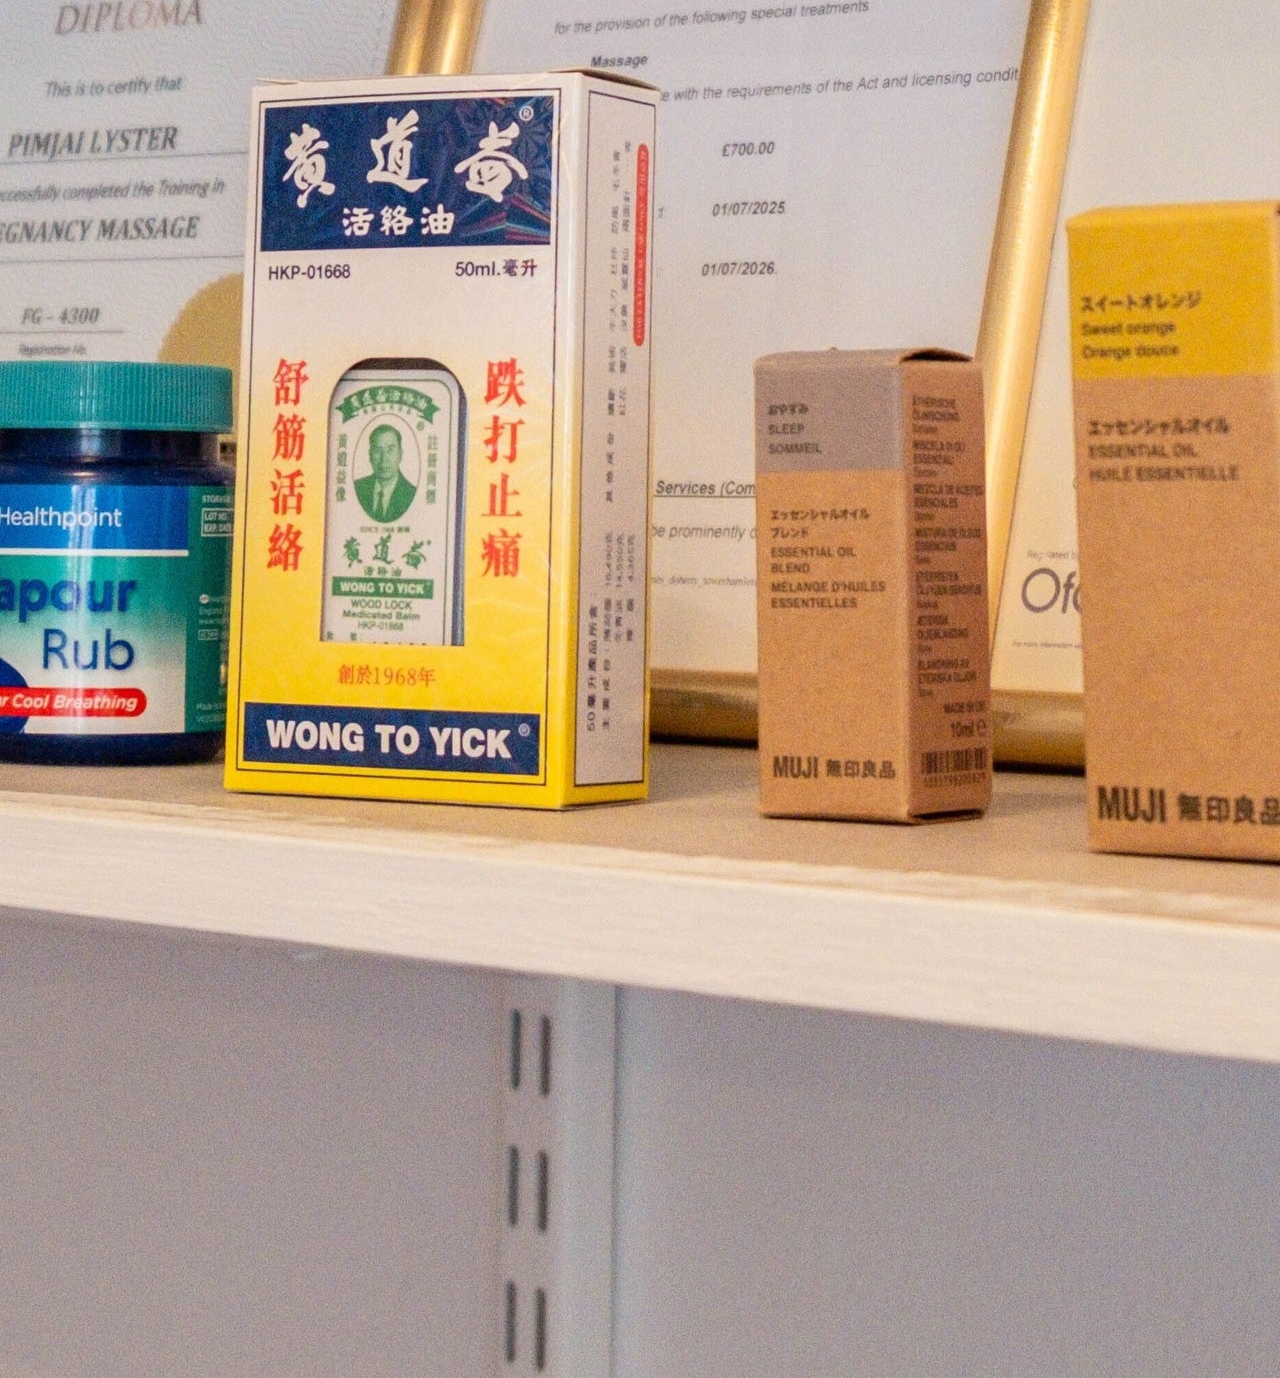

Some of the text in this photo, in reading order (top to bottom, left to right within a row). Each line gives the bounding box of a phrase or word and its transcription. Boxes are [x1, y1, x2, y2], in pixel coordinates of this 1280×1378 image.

[595, 15, 650, 33] provision
[670, 12, 689, 26] the
[692, 7, 746, 25] following
[751, 4, 795, 24] special
[590, 54, 648, 70] Massage
[46, 76, 183, 97] This certify that
[673, 87, 699, 102] with
[703, 85, 723, 100] the
[726, 81, 812, 101] requirements
[816, 79, 830, 94] of
[832, 78, 853, 93] the
[857, 76, 879, 92] Act
[882, 74, 908, 90] and
[912, 69, 972, 88] licensing
[976, 68, 1019, 83] condit
[7, 125, 179, 162] PIMJAI LYSTER
[722, 141, 776, 157] £700.00
[63, 183, 130, 202] completed
[132, 181, 153, 196] the
[160, 177, 210, 198] Training
[712, 200, 786, 217] 01/07/2025
[96, 215, 200, 241] MASSAGE
[342, 204, 456, 237] 活絡油
[268, 263, 351, 281] HKP-01668
[455, 258, 539, 278] 50ml.毫升
[60, 307, 101, 325] 4300
[1126, 322, 1176, 338] orange
[1082, 345, 1131, 361] Orange
[768, 424, 804, 435] SLEEP
[768, 443, 823, 455] SOMMEIL
[266, 357, 310, 572] 舒筋活絡
[481, 357, 527, 578] 跌打止痛
[655, 480, 716, 495] Services
[669, 524, 746, 543] prominently
[771, 546, 856, 557] ESSENTIAL OIL
[771, 563, 810, 574] BLEND
[340, 581, 425, 595] WONG TO YICK
[771, 580, 829, 593] MÉLANGE
[351, 599, 413, 611] WOOD LOCK
[771, 597, 859, 609] ESSENTIELLES
[342, 610, 421, 621] Medicated Balm
[42, 628, 136, 672] Rub
[336, 663, 438, 688] 創於1968年
[12, 692, 50, 709] Cool
[53, 694, 139, 713] Breathing
[265, 718, 513, 760] WONG TO YICK
[773, 755, 896, 780] MUJI 無印良品
[1097, 785, 1168, 824] MUJI
